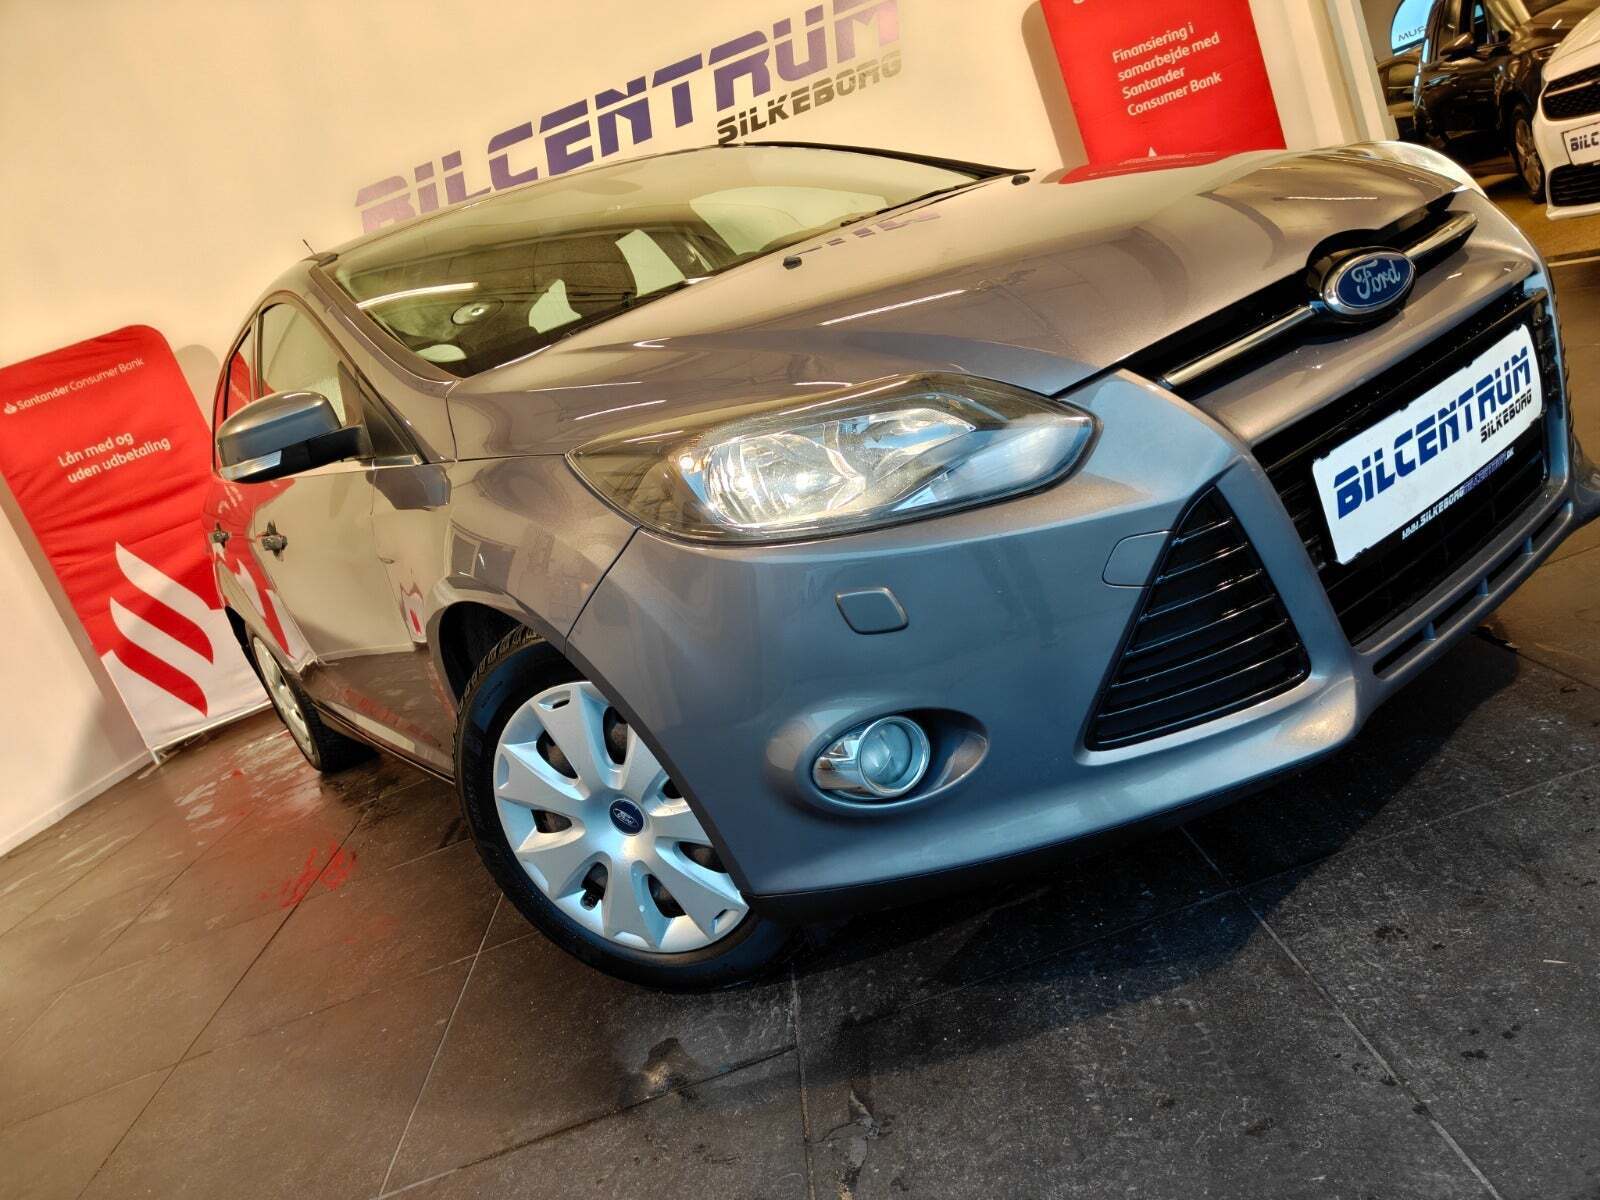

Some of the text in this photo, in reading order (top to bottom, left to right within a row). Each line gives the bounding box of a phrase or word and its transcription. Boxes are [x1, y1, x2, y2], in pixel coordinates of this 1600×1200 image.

[1112, 21, 1195, 63] Finansiering i
[1117, 32, 1221, 82] samarbejde med
[716, 50, 902, 145] SILKEBORG
[1122, 67, 1186, 99] Santander
[1127, 71, 1222, 117] Consumer Bank
[355, 0, 900, 234] BILCENTRUM
[1351, 259, 1401, 300] Ford
[16, 357, 145, 410] Santander Consumer Bank
[1333, 345, 1532, 519] BILCENTRUM
[1480, 388, 1532, 444] SILKEBORG
[58, 432, 134, 467] Lån med og
[67, 438, 171, 483] uden udbetaling
